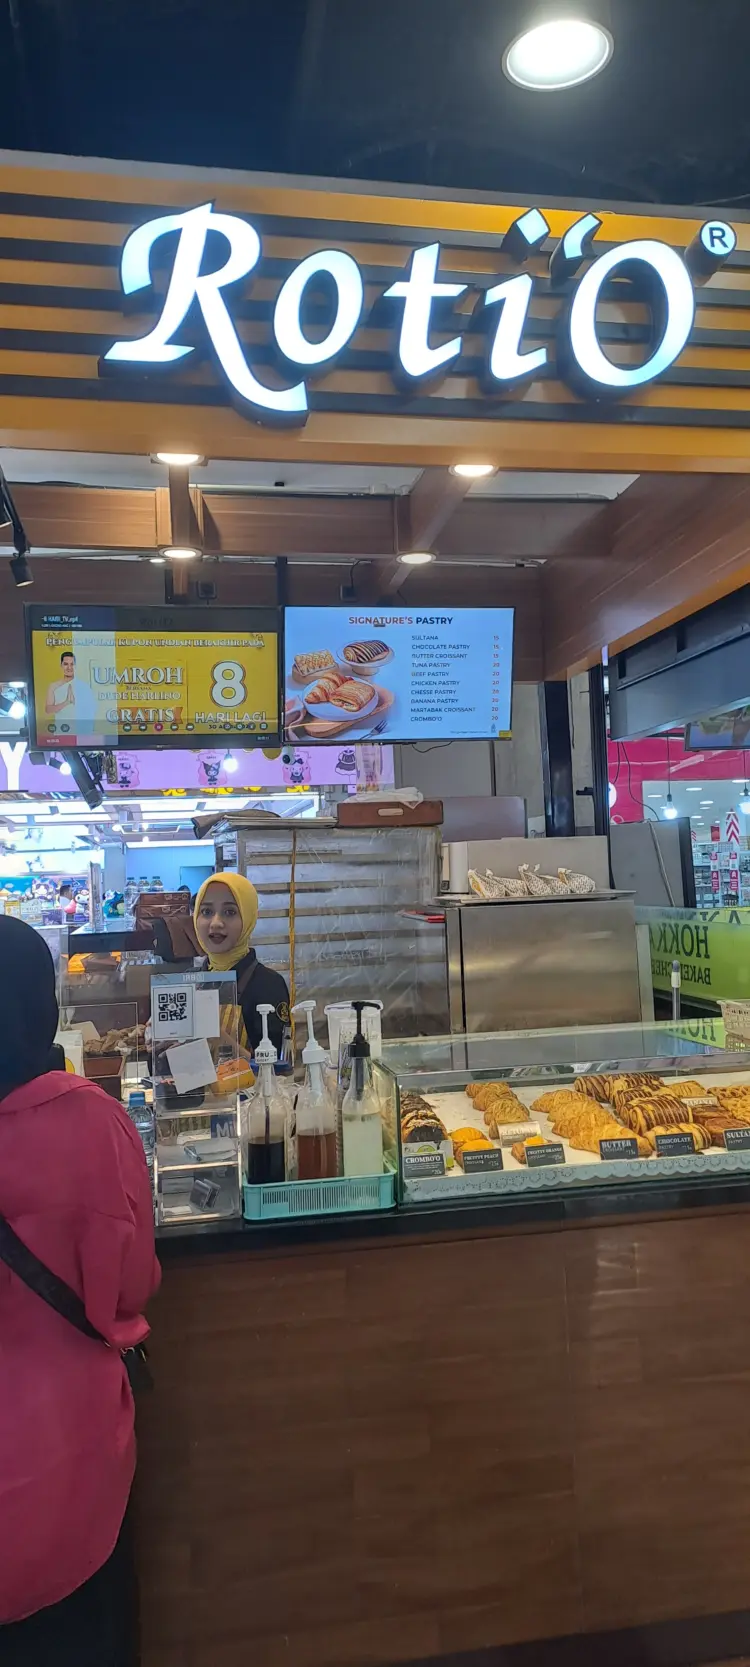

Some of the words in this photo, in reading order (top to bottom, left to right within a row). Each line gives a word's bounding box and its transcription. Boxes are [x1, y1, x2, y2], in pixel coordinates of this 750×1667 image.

[348, 616, 413, 625] SIGNATURE'S
[416, 616, 453, 625] PASTRY
[118, 638, 153, 648] KUPON
[92, 666, 183, 685] UMROH
[210, 660, 247, 708] 8
[106, 707, 175, 724] GRATIS
[195, 711, 230, 724] HARI
[233, 710, 268, 723] LAGI
[601, 1140, 632, 1149] BUTTER
[657, 1136, 691, 1145] CHOCOLATE
